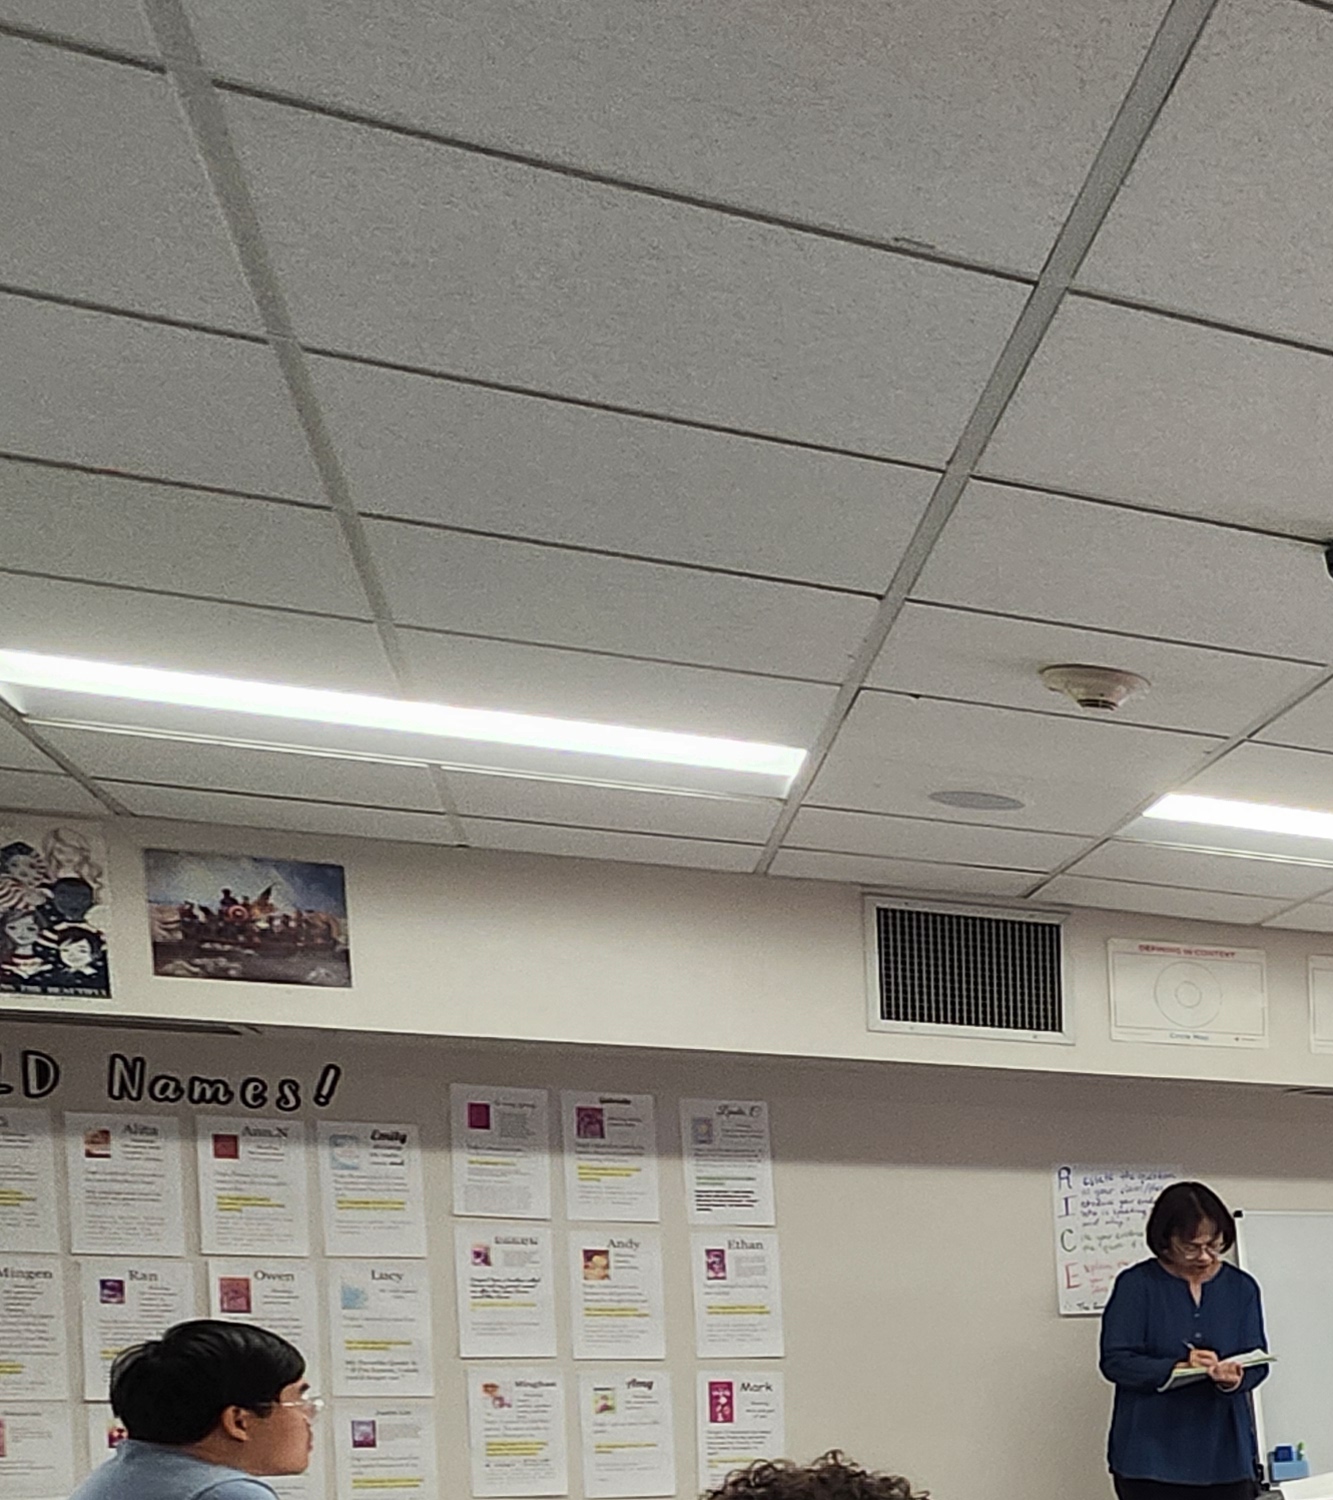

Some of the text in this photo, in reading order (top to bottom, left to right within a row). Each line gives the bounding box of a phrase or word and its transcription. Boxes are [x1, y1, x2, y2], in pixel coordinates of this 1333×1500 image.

[1194, 949, 1236, 958] CONTEXT
[0, 1049, 342, 1112] D Names!
[607, 1239, 640, 1250] Andy
[727, 1239, 764, 1250] Ethan
[253, 1269, 295, 1281] Owen
[740, 1382, 773, 1393] Mark
